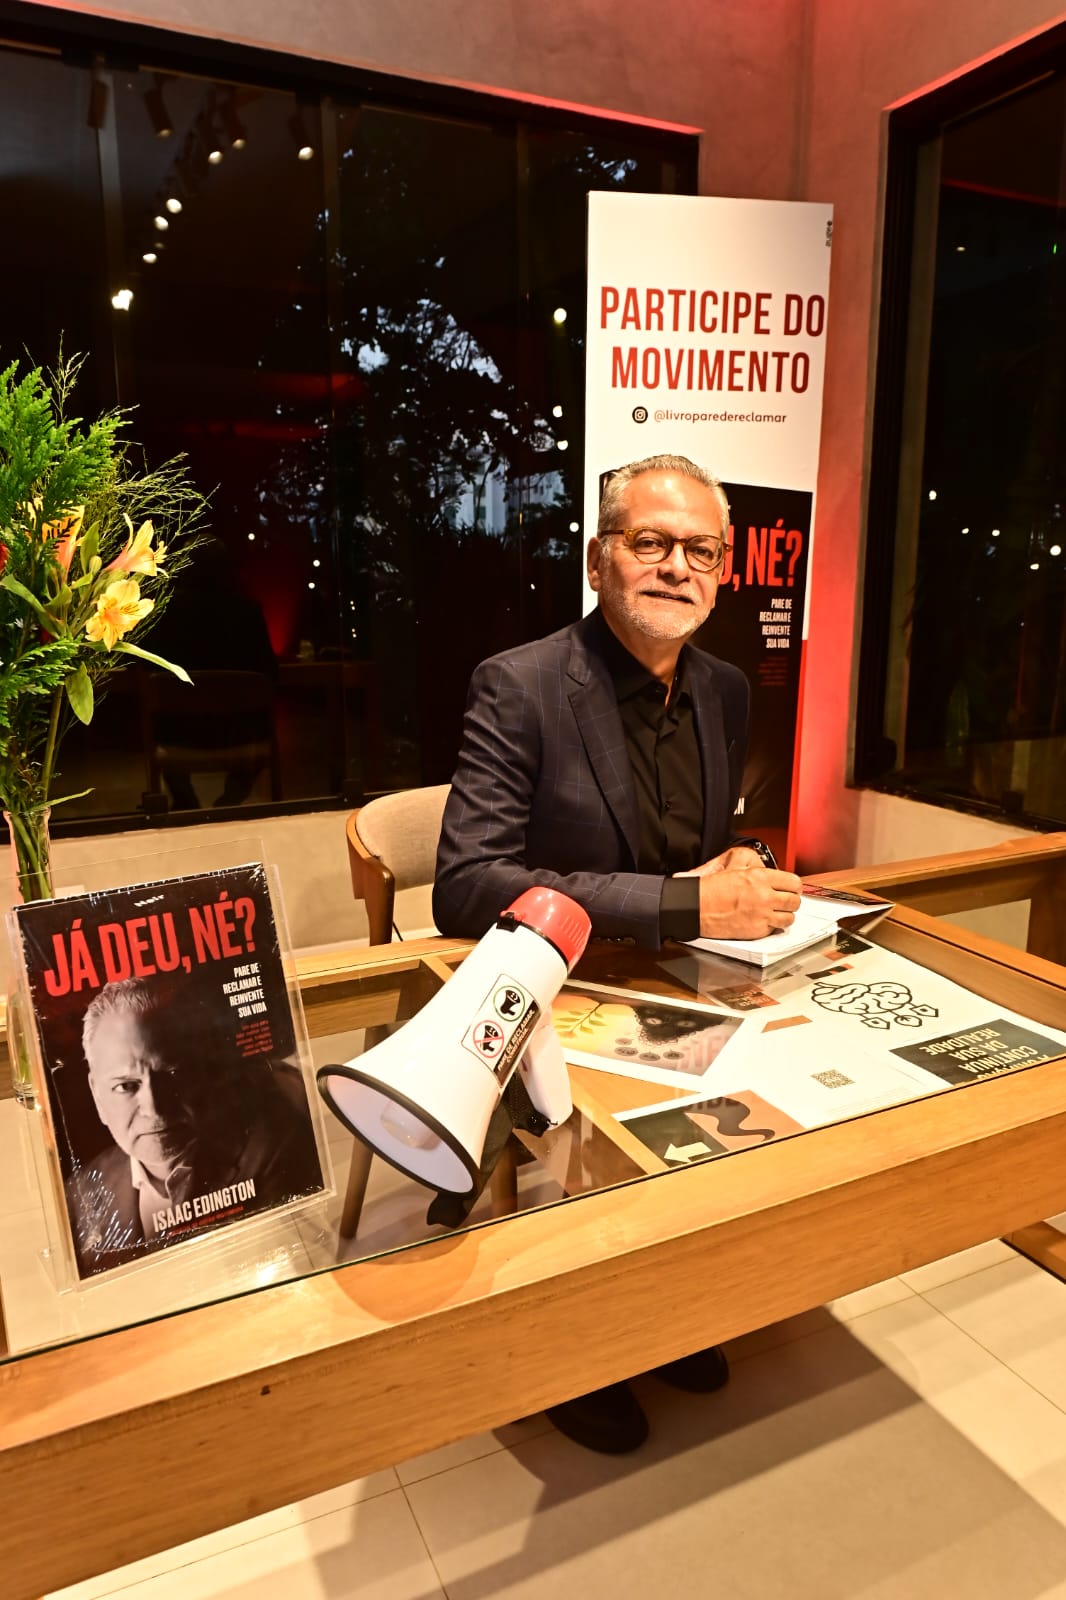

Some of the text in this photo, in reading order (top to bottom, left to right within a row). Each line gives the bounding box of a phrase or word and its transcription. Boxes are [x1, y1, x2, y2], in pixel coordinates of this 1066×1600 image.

[600, 286, 825, 337] PARTICIPE DO
[611, 346, 810, 393] MOVIMENTO
[654, 410, 787, 424] @livroparedereclamar
[746, 519, 803, 587] NÉ?
[771, 598, 792, 609] PARE DE
[759, 611, 787, 622] RECLAMAR
[762, 625, 790, 635] REINVENTE
[766, 638, 790, 648] SUA VIDA
[44, 889, 256, 997] JÁ DEU, NÉ?
[234, 963, 260, 977] PARE DE
[222, 976, 262, 994] RECLAMAR E
[229, 988, 265, 1007] REINVENTE
[238, 1001, 267, 1018] SUA VIDA
[919, 1028, 1001, 1056] REALIDADE
[948, 1040, 1008, 1061] DA SUA
[152, 1201, 193, 1233] ISAAC
[192, 1178, 256, 1218] EDINGTON
